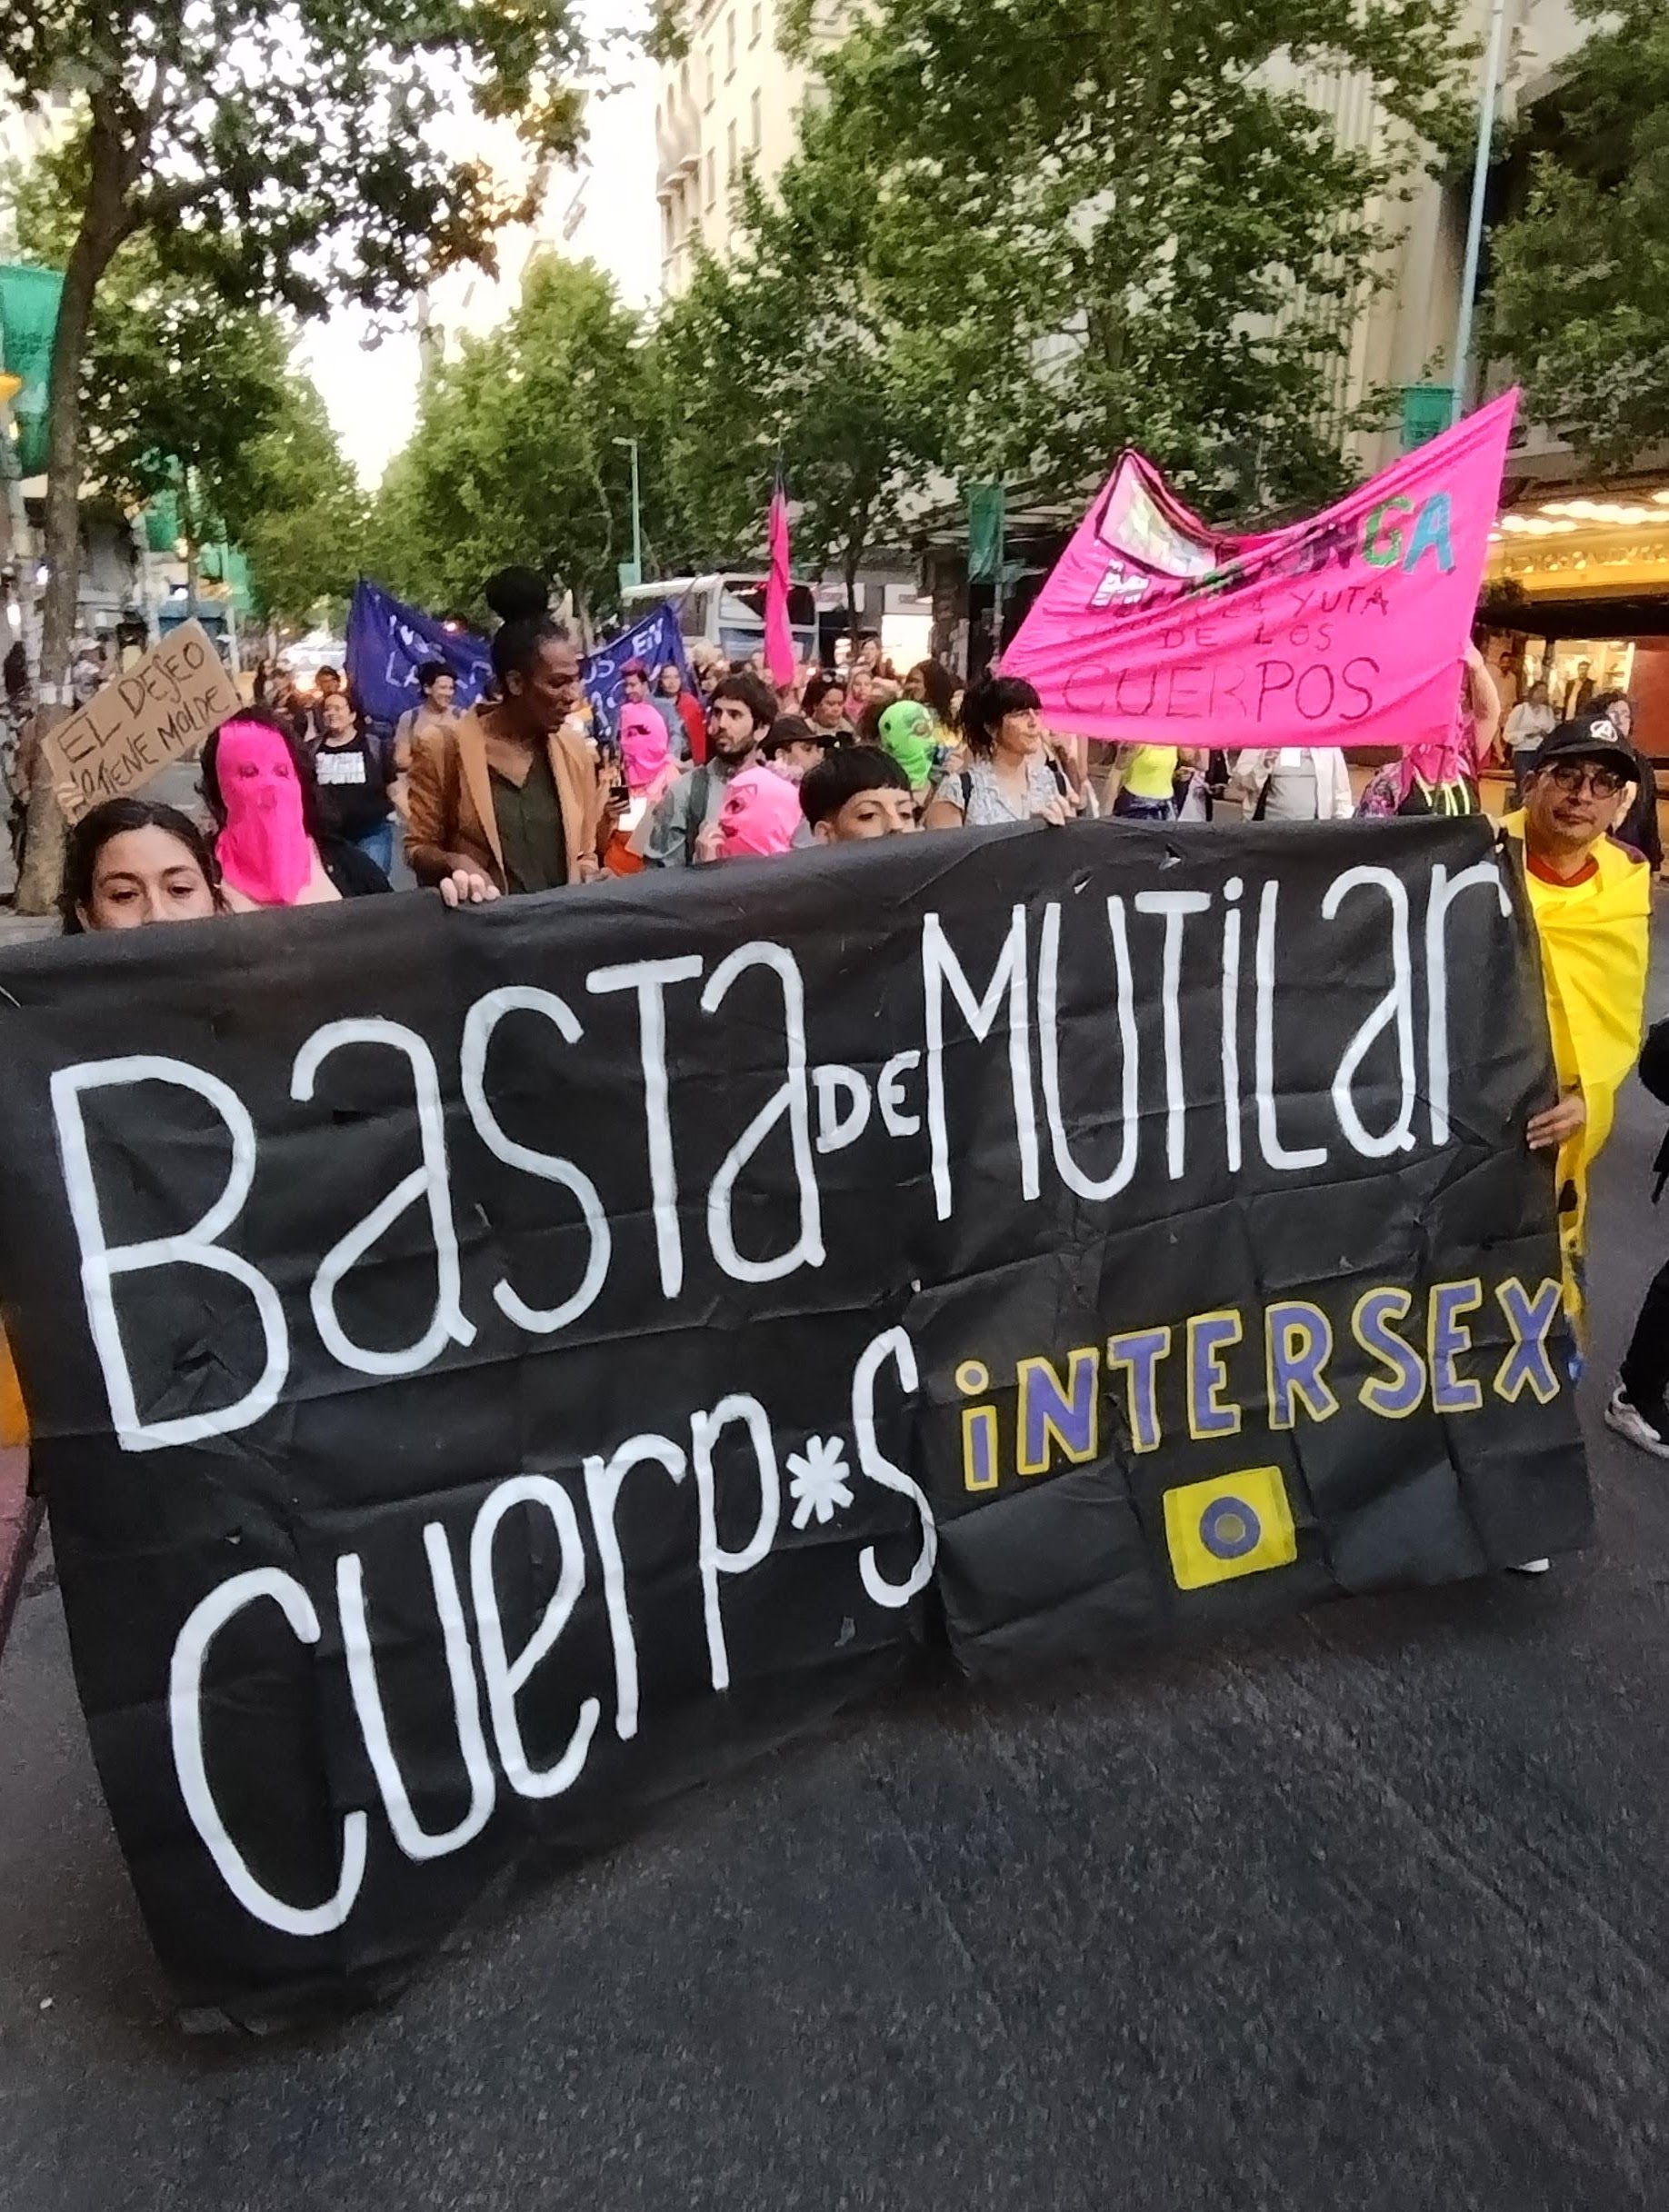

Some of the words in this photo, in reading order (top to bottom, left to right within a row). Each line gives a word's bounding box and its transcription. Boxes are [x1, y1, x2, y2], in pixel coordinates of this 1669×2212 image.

[1290, 585, 1390, 618] YUTA
[1159, 627, 1219, 650] DE
[1252, 622, 1334, 652] LOS
[156, 685, 231, 752] MOLDE
[1061, 656, 1381, 723] CUERPOS
[57, 711, 122, 764] EL
[812, 1050, 922, 1153] DE
